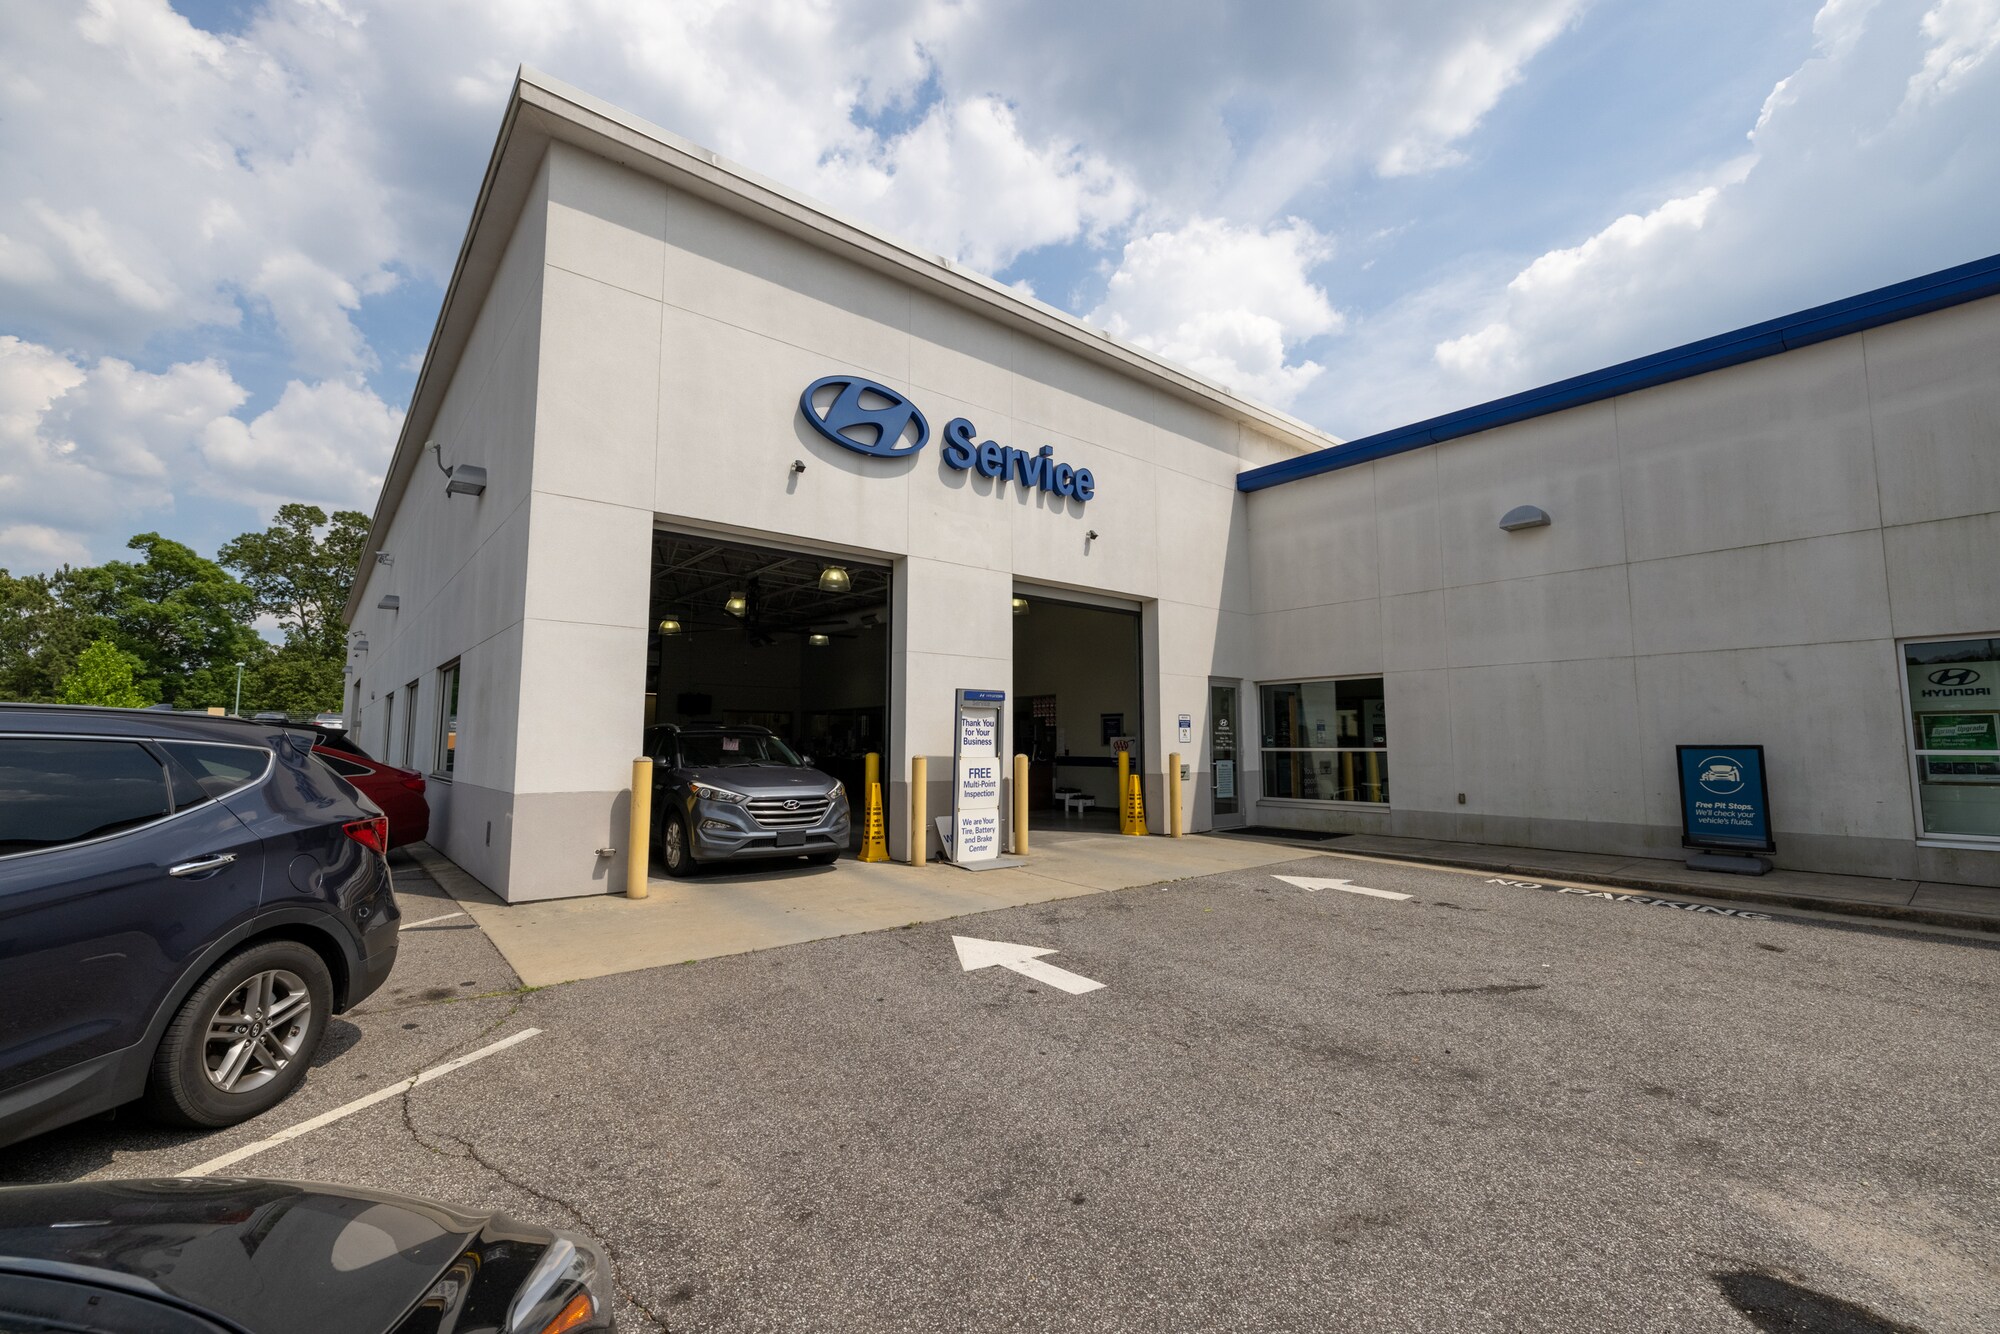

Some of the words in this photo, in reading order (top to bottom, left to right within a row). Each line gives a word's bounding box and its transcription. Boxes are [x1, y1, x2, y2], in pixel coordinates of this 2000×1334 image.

[943, 418, 1095, 502] Service
[1921, 687, 1991, 698] HYUNDAI
[962, 718, 981, 727] Thank
[982, 719, 995, 728] You
[965, 727, 974, 736] for
[975, 728, 990, 737] Your
[1957, 724, 1985, 732] Upgrade
[963, 737, 992, 746] Business
[968, 767, 992, 779] FREE
[963, 780, 996, 788] Multi-Point
[964, 790, 995, 799] Inspection
[1695, 801, 1713, 809] Free
[1728, 802, 1754, 811] Stops.
[1713, 809, 1736, 817] check
[962, 818, 972, 826] We
[982, 817, 995, 825] Your
[1698, 817, 1729, 825] vehicle's
[1730, 818, 1754, 826] fluids.
[961, 827, 974, 835] Tire,
[975, 826, 996, 835] Battery
[964, 836, 976, 844] and
[976, 835, 993, 843] Brake
[968, 844, 988, 853] Center
[1485, 878, 1543, 889] NO
[1558, 887, 1773, 920] PARKING
